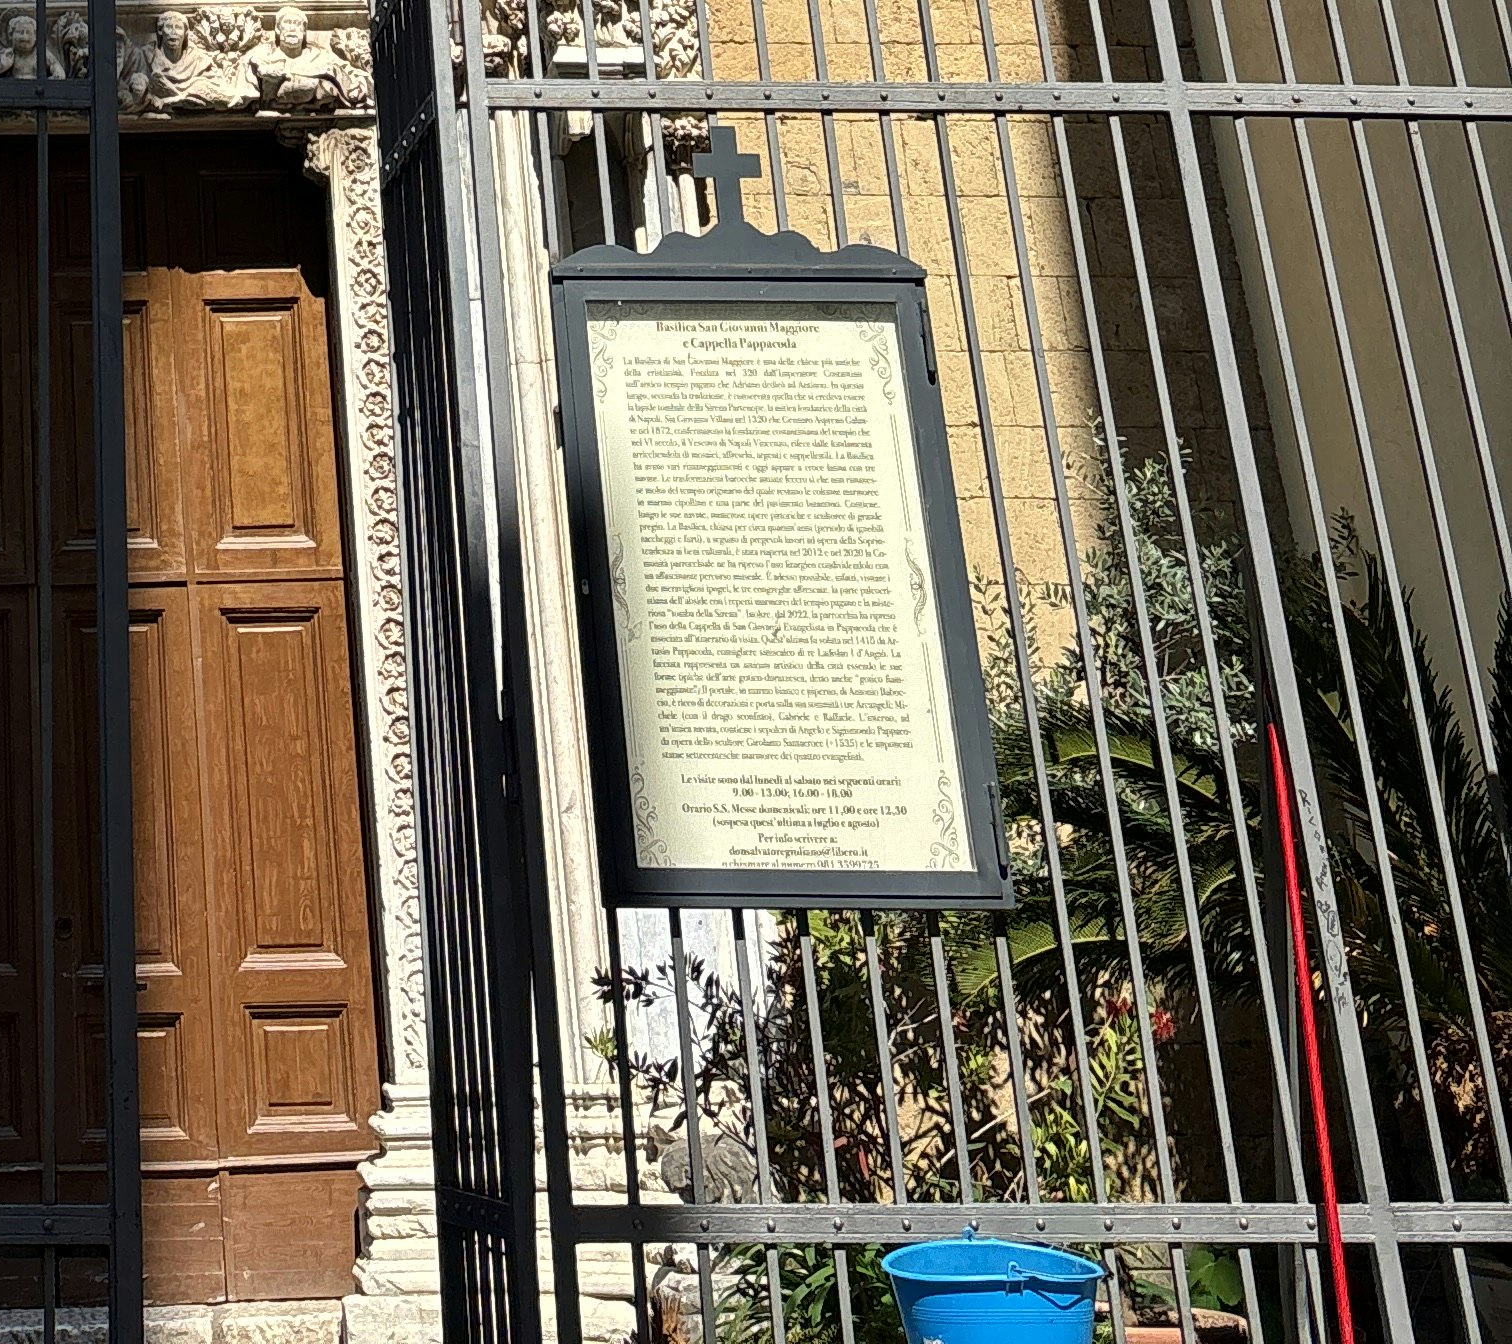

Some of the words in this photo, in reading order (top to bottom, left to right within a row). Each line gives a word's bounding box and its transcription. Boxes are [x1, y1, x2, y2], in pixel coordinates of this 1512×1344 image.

[656, 321, 696, 332] Basilica
[699, 322, 718, 332] San
[720, 322, 767, 332] Giovanni
[770, 322, 819, 335] Maggiore
[691, 338, 737, 351] Cappella
[682, 803, 712, 813] Orario
[732, 803, 757, 814] Messe
[758, 833, 774, 843] Per
